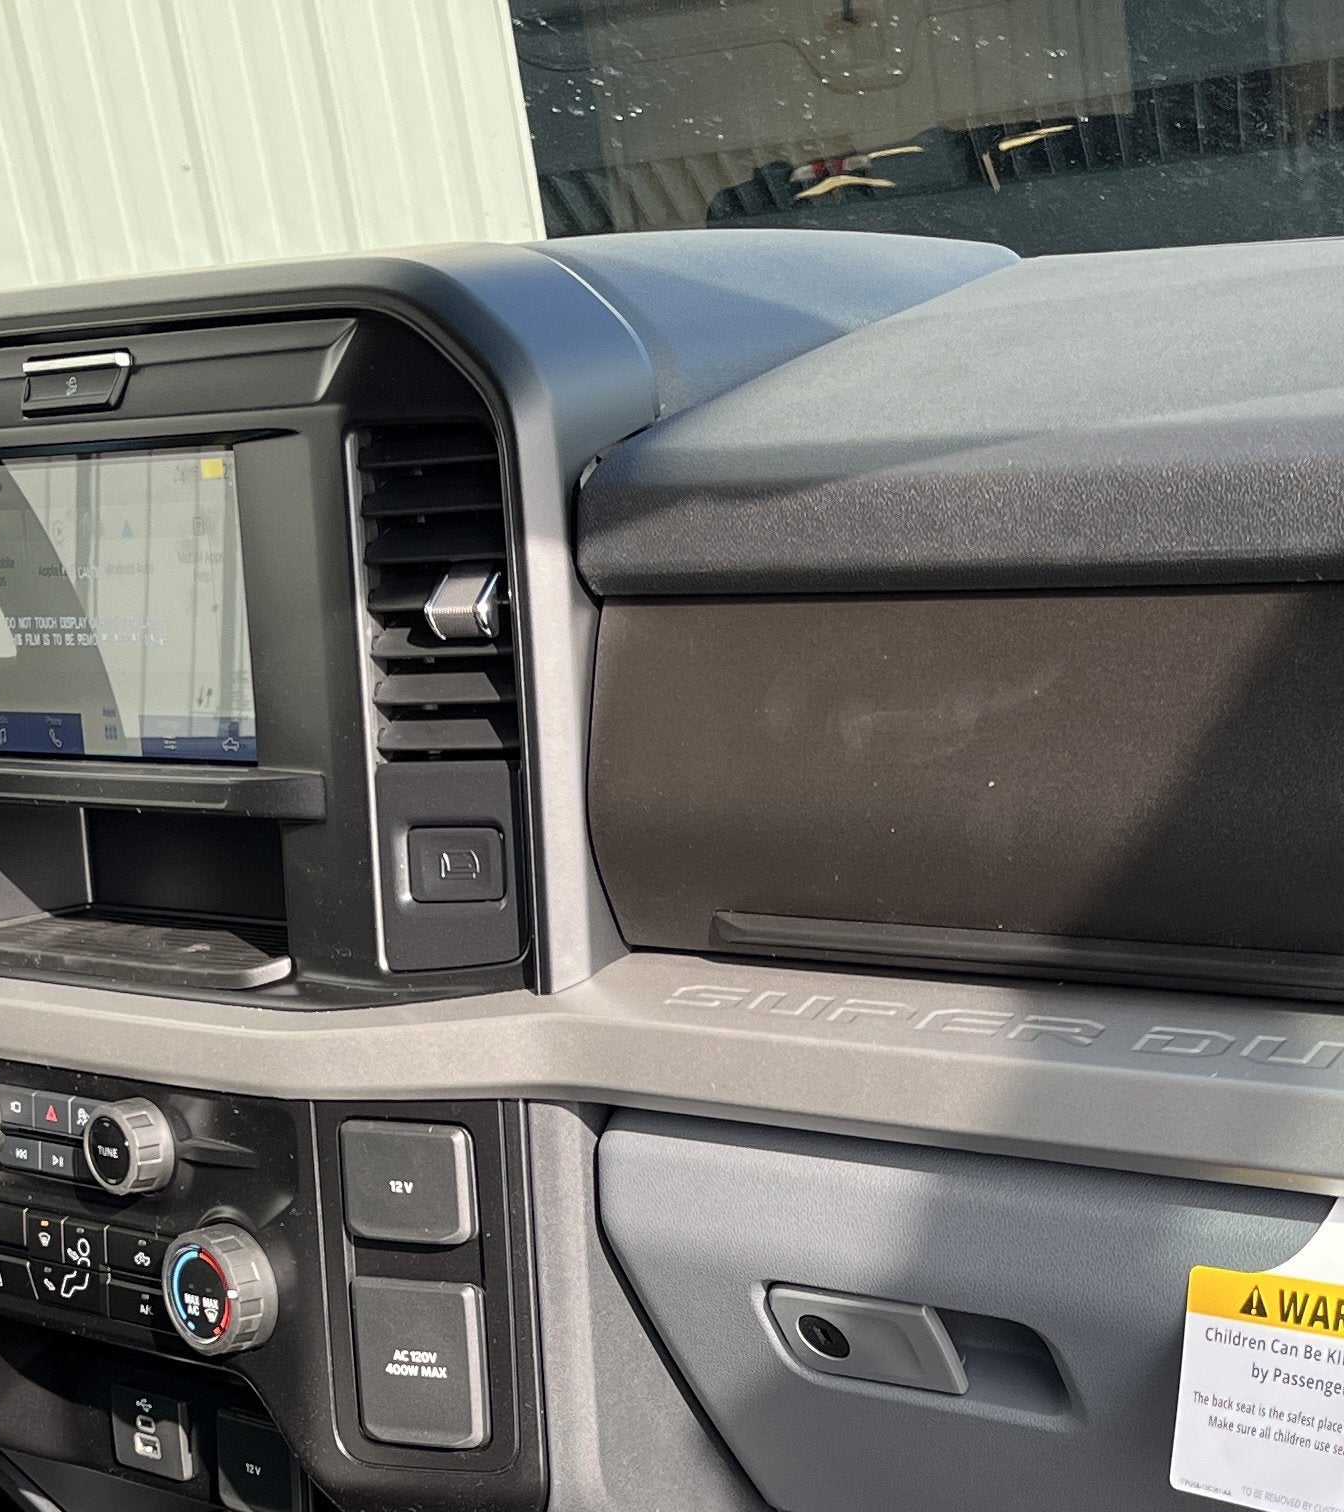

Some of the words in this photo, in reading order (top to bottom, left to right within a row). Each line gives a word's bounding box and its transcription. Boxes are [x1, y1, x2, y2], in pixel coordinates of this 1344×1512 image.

[18, 616, 32, 629] NOT
[34, 616, 58, 629] TOUCH
[59, 616, 88, 630] DISPLAY
[24, 633, 41, 646] FILM
[42, 633, 51, 646] IS
[52, 633, 63, 646] TO
[64, 633, 76, 647] BE
[666, 984, 1107, 1047] SUPER
[97, 1145, 119, 1160] TUNE
[1205, 1327, 1266, 1351] Children
[1271, 1339, 1299, 1357] Can
[1303, 1344, 1322, 1361] Be
[392, 1349, 409, 1362] AC
[410, 1350, 437, 1364] 120V
[385, 1362, 419, 1377] 400W
[421, 1365, 447, 1379] MAX
[1251, 1362, 1269, 1384] by
[1193, 1390, 1210, 1406] The
[1211, 1394, 1234, 1410] back
[1236, 1400, 1256, 1416] seat
[1258, 1405, 1266, 1418] is
[1268, 1406, 1285, 1422] the
[1286, 1410, 1316, 1429] safest
[1316, 1417, 1343, 1434] place
[1207, 1414, 1234, 1432] Make
[1236, 1423, 1257, 1437] sure
[1258, 1426, 1272, 1440] all
[1273, 1430, 1312, 1449] children
[1314, 1438, 1331, 1453] use
[1241, 1485, 1252, 1497] TO
[1253, 1486, 1264, 1500] BE
[1264, 1490, 1302, 1509] REMOVED
[1302, 1500, 1314, 1511] BY
